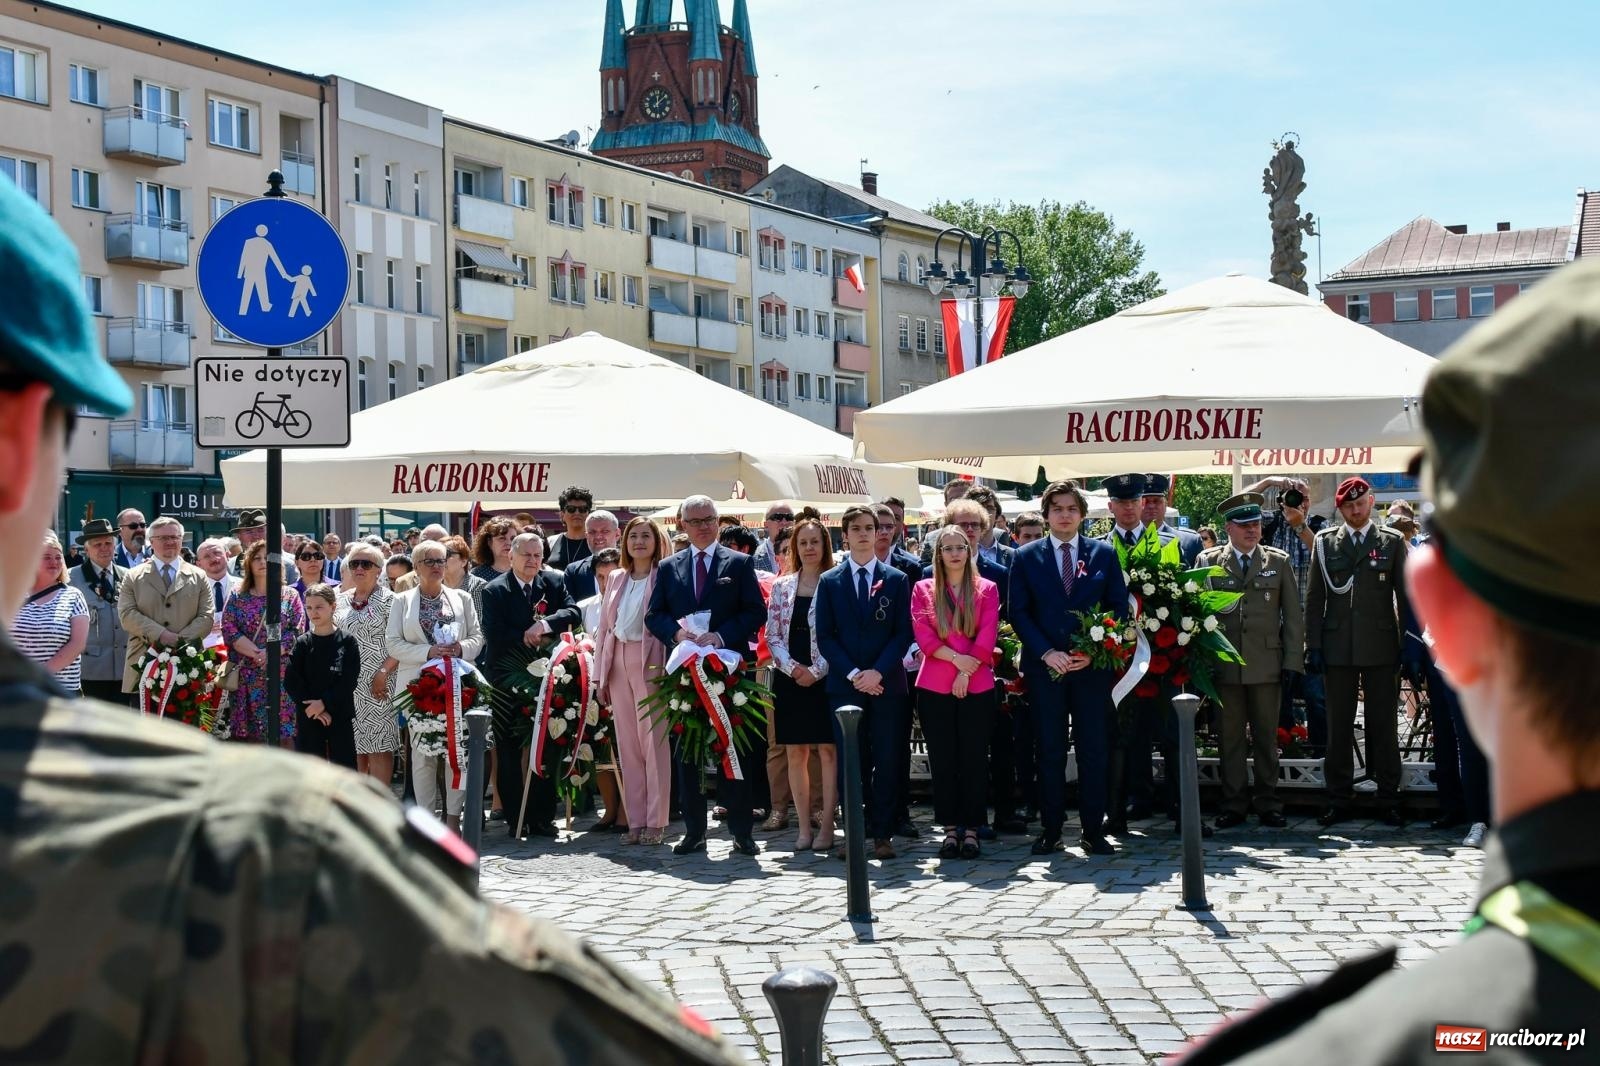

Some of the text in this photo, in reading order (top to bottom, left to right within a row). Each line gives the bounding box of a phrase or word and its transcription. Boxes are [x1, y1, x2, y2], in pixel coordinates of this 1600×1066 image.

[206, 363, 342, 387] Nie dotyczy
[1066, 408, 1264, 444] RACIBORSKIE
[392, 463, 551, 494] RACIBORSKIE
[814, 464, 870, 496] RACIBORSKIE
[160, 493, 220, 509] JUBIL
